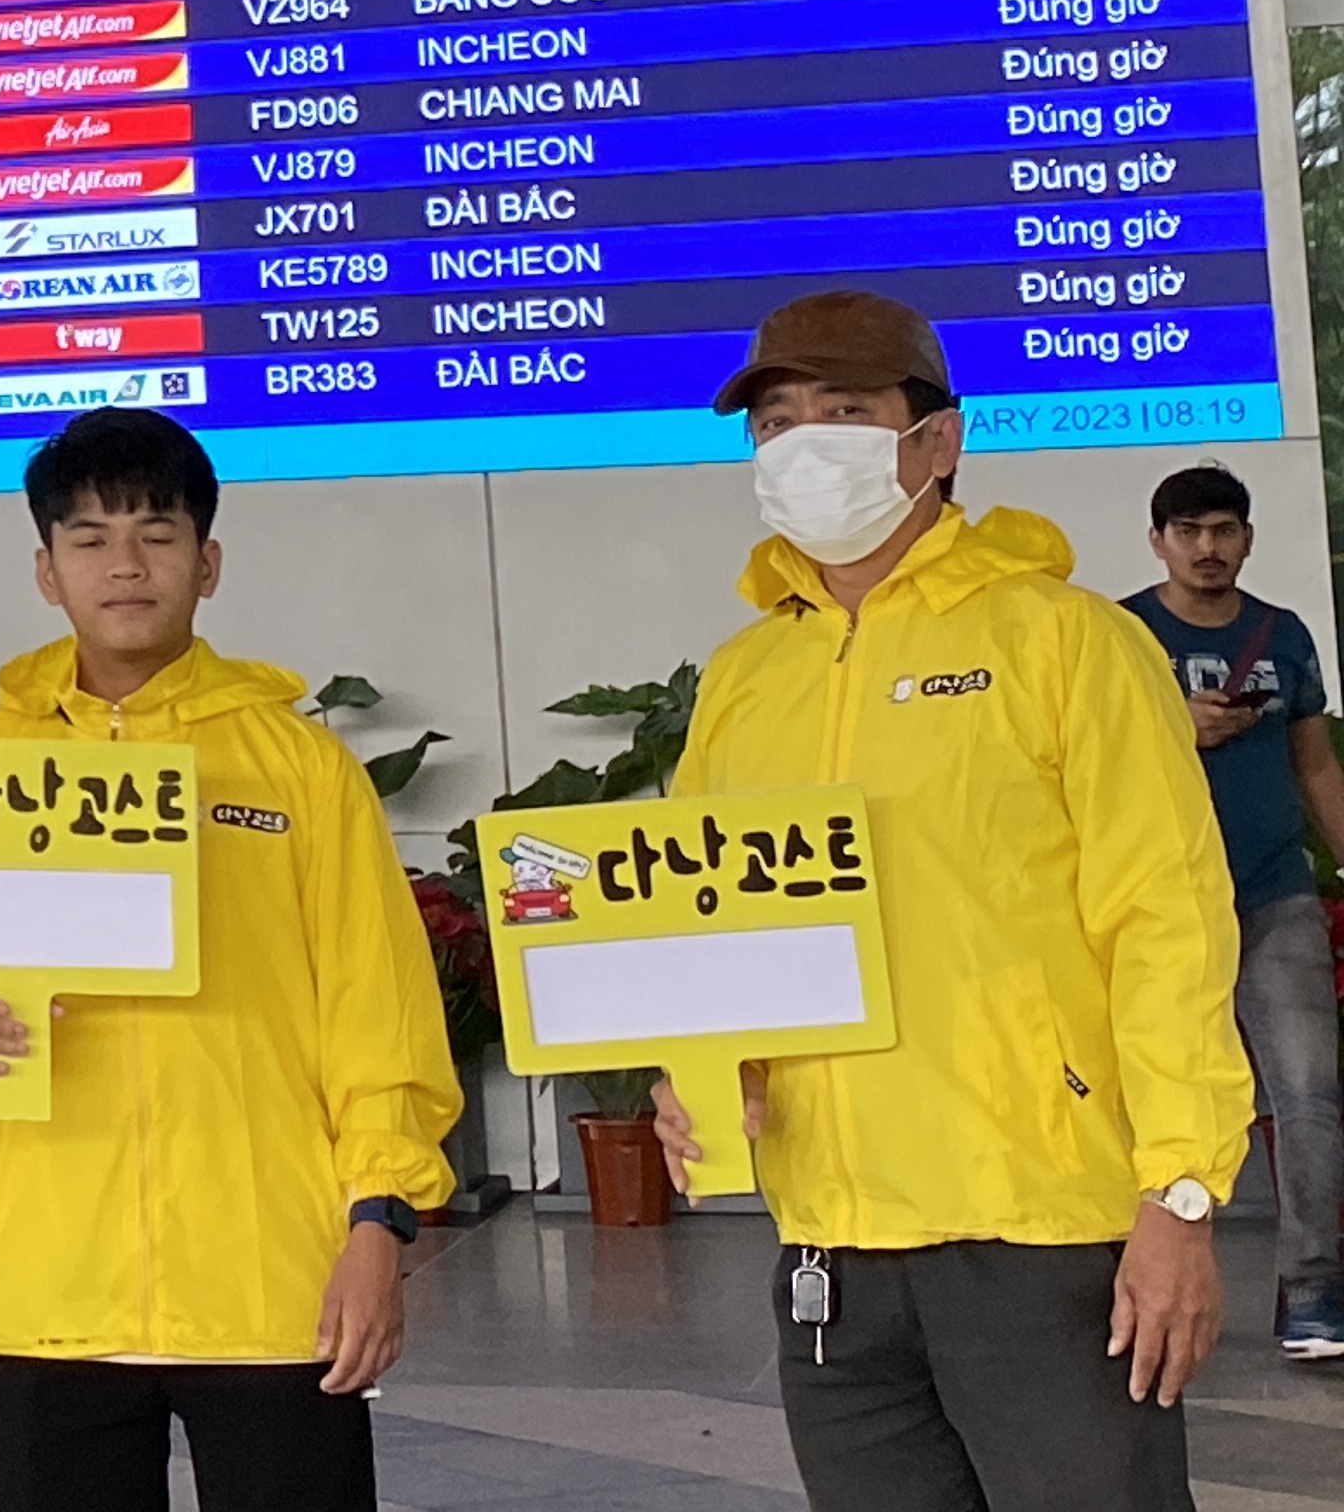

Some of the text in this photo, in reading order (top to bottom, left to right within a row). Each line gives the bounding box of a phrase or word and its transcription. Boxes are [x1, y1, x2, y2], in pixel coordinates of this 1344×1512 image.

[245, 42, 345, 78] VJ881
[417, 27, 587, 67] INCHEON
[250, 94, 359, 131] FD906
[419, 82, 565, 120] CHIANG
[573, 77, 641, 110] MAI
[1001, 46, 1099, 82] Đúng
[1108, 39, 1168, 80] giờ
[251, 148, 356, 183] VJ879
[424, 134, 595, 173] INCHEON
[1006, 103, 1103, 138] Đúng
[1113, 96, 1172, 136] giờ
[47, 228, 165, 251] STARLUX
[255, 200, 355, 236] JX701
[424, 188, 488, 227] ĐÀI
[497, 184, 576, 223] BẮC
[1009, 158, 1108, 194] Đúng
[1117, 151, 1177, 192] giờ
[100, 273, 157, 294] AIR
[259, 253, 388, 289] KE5789
[431, 242, 602, 280] INCHEON
[1014, 214, 1112, 250] Đúng
[1122, 208, 1181, 249] giờ
[260, 306, 380, 342] TW125
[433, 296, 605, 334] INCHEON
[1016, 269, 1116, 306] Đúng
[1126, 264, 1186, 305] giờ
[266, 361, 377, 395] BR383
[435, 350, 499, 388] ĐÀI
[509, 346, 586, 385] BẮC
[1022, 327, 1120, 363] Đúng
[1131, 322, 1190, 361] giờ
[964, 406, 1040, 437] ARY
[1051, 402, 1131, 432] 2023
